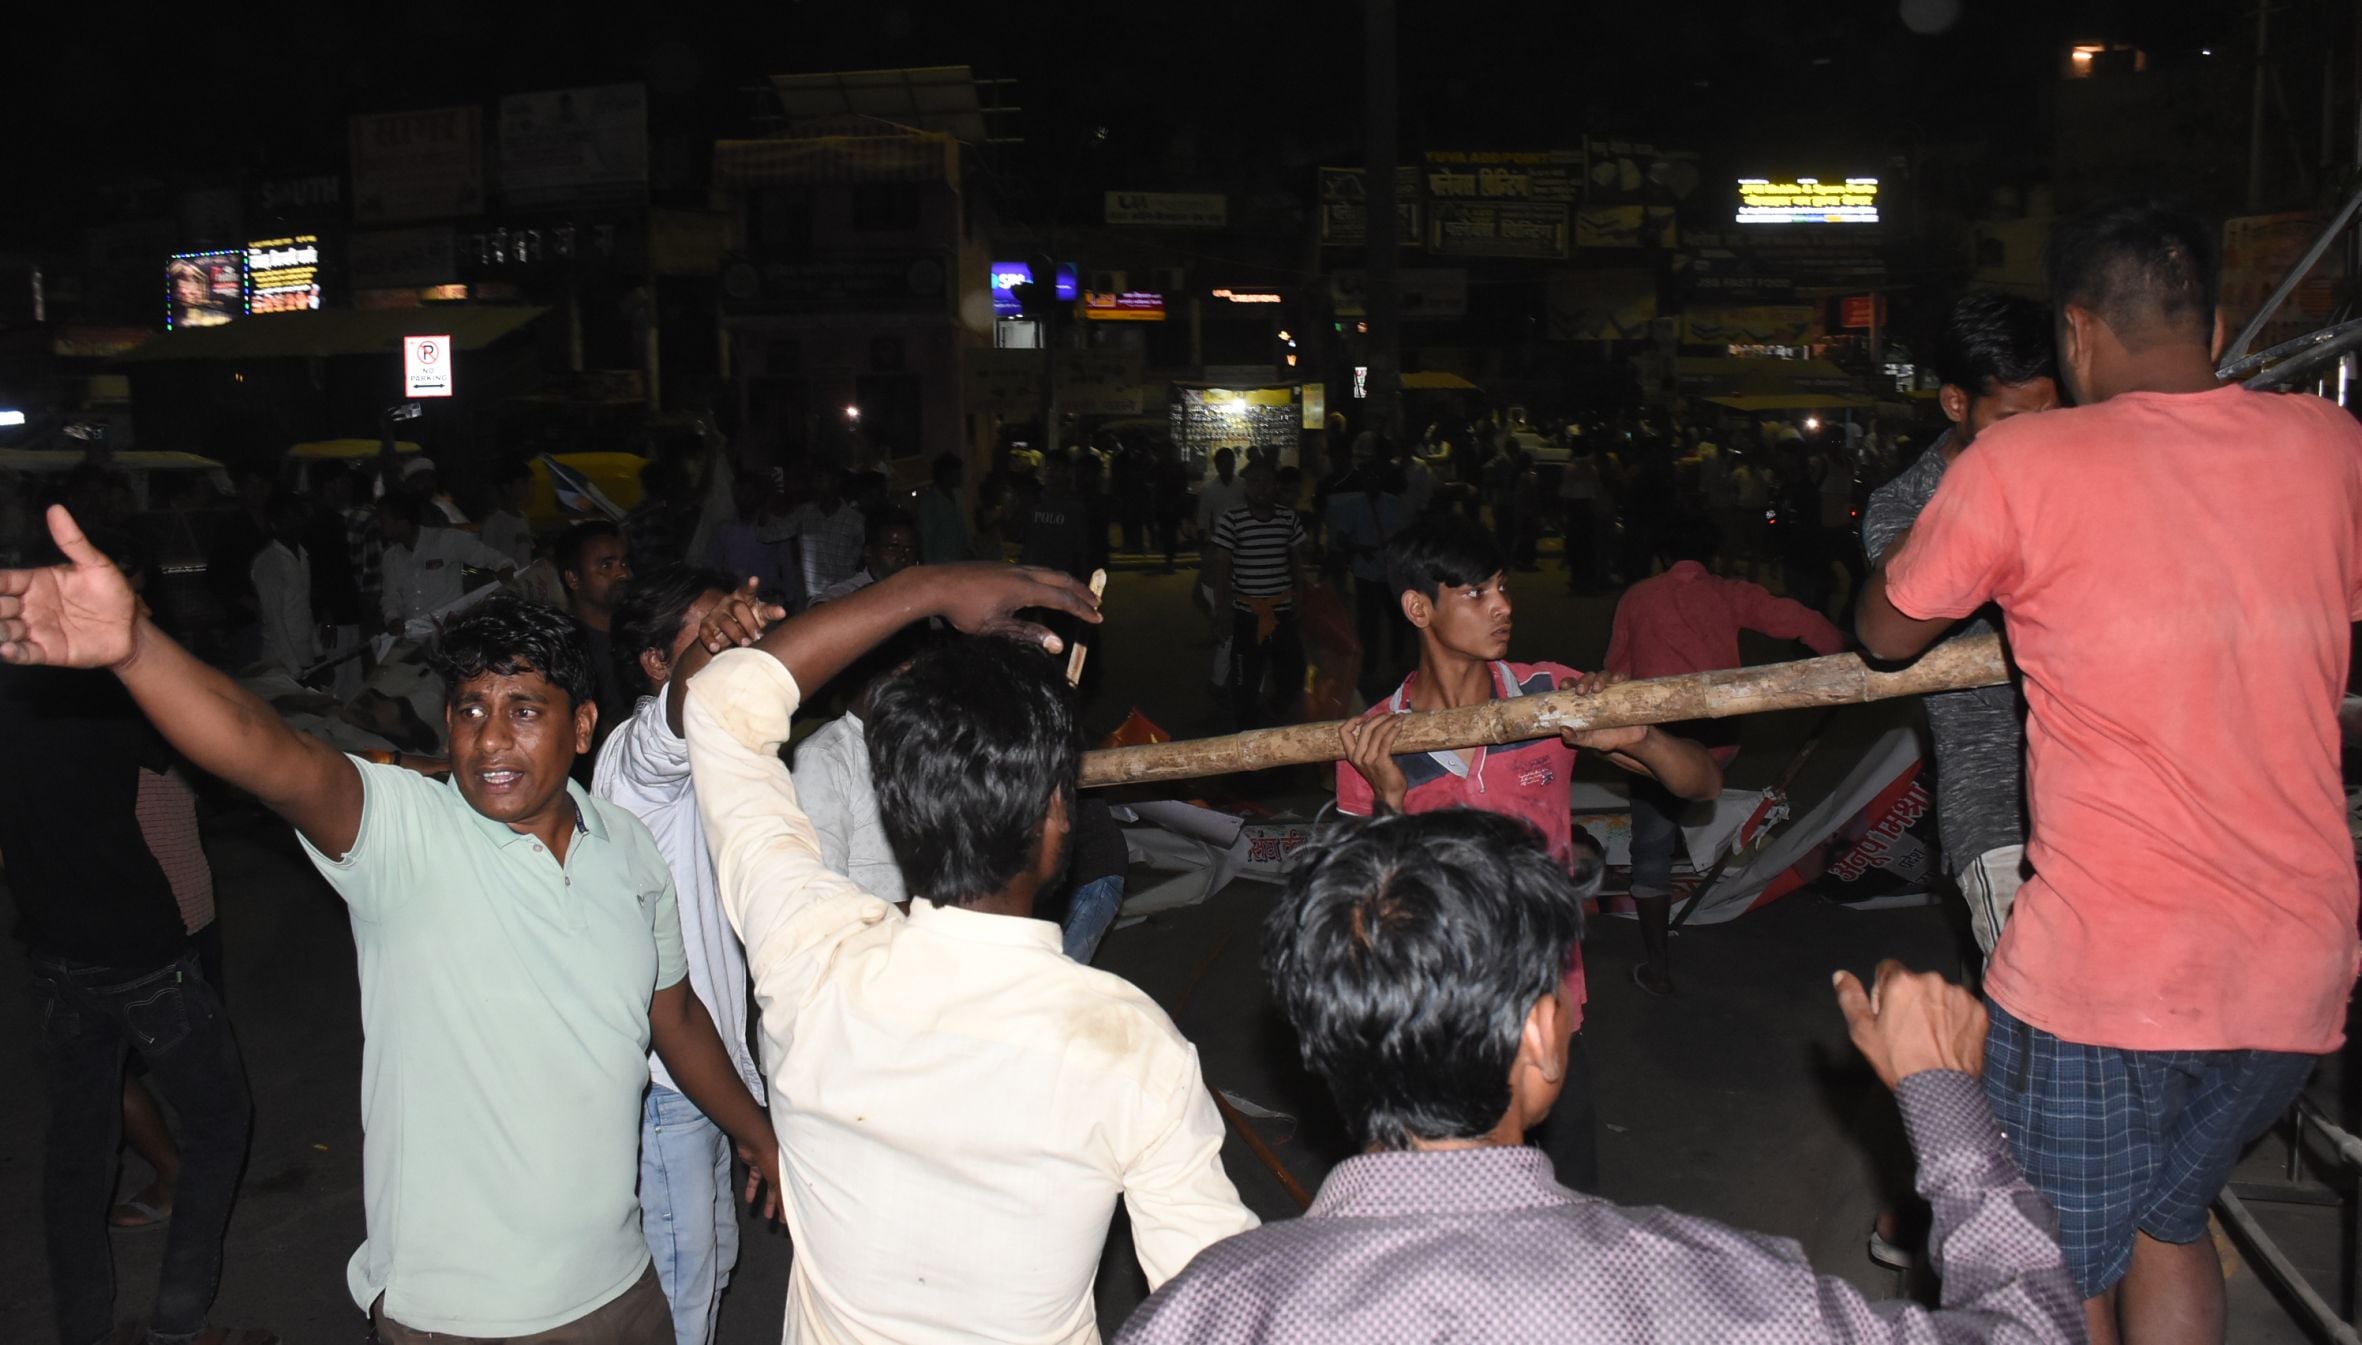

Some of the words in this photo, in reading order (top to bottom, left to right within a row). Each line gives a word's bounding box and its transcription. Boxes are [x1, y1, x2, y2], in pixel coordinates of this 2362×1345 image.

[410, 374, 448, 382] PARKING
[1033, 511, 1065, 526] POLO
[1827, 829, 1893, 882] अनूप
[1870, 780, 1929, 842] मिश्रा
